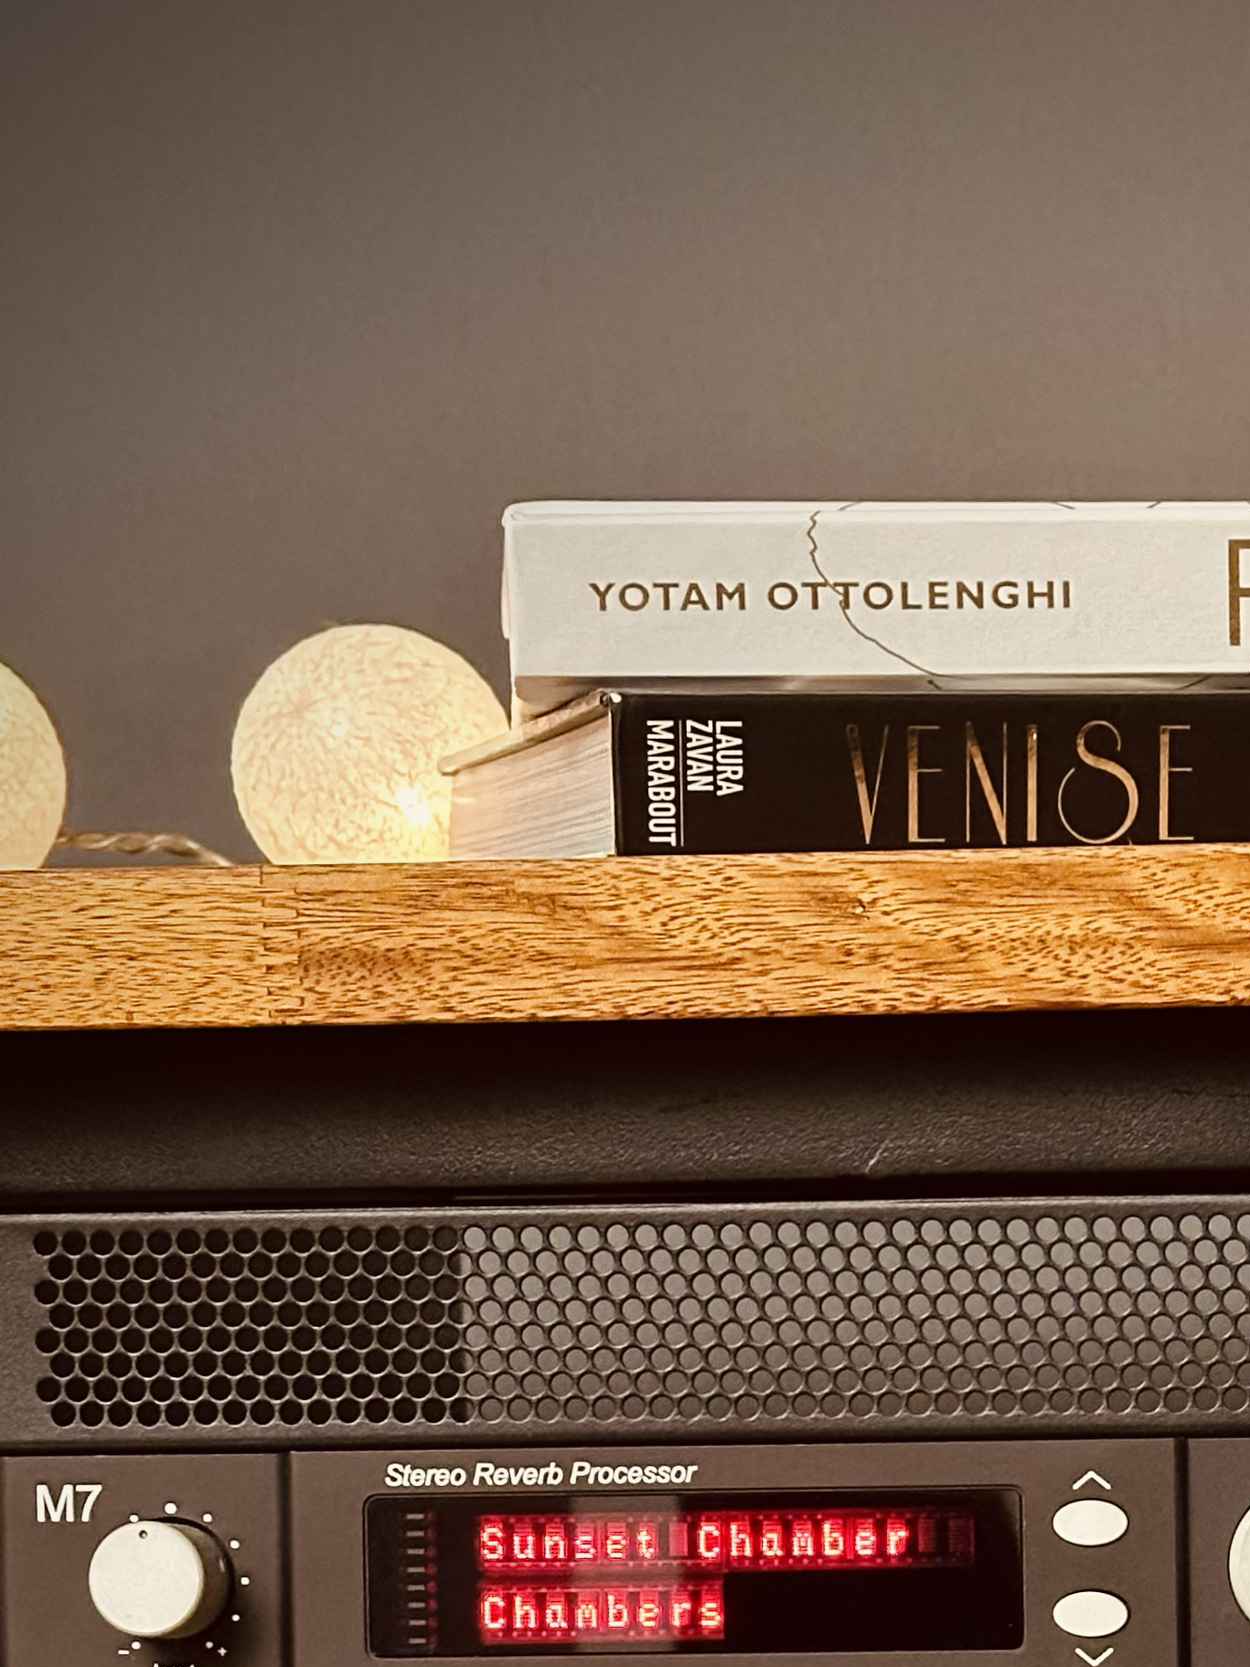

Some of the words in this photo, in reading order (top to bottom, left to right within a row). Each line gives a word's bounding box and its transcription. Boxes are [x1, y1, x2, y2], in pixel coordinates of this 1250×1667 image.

[588, 582, 747, 612] YOTAM
[766, 580, 1073, 611] OTTOLENGHI
[686, 719, 714, 791] ZAVAN
[715, 720, 744, 796] LAURA
[646, 720, 677, 846] MARABOUT
[845, 720, 1196, 845] VENISE
[385, 1463, 467, 1487] Stereo
[473, 1461, 565, 1486] Reverb
[569, 1459, 698, 1485] Processor
[35, 1484, 103, 1523] M7
[483, 1525, 657, 1562] Sunset
[697, 1519, 909, 1557] Chamber
[483, 1595, 724, 1631] Chambers
